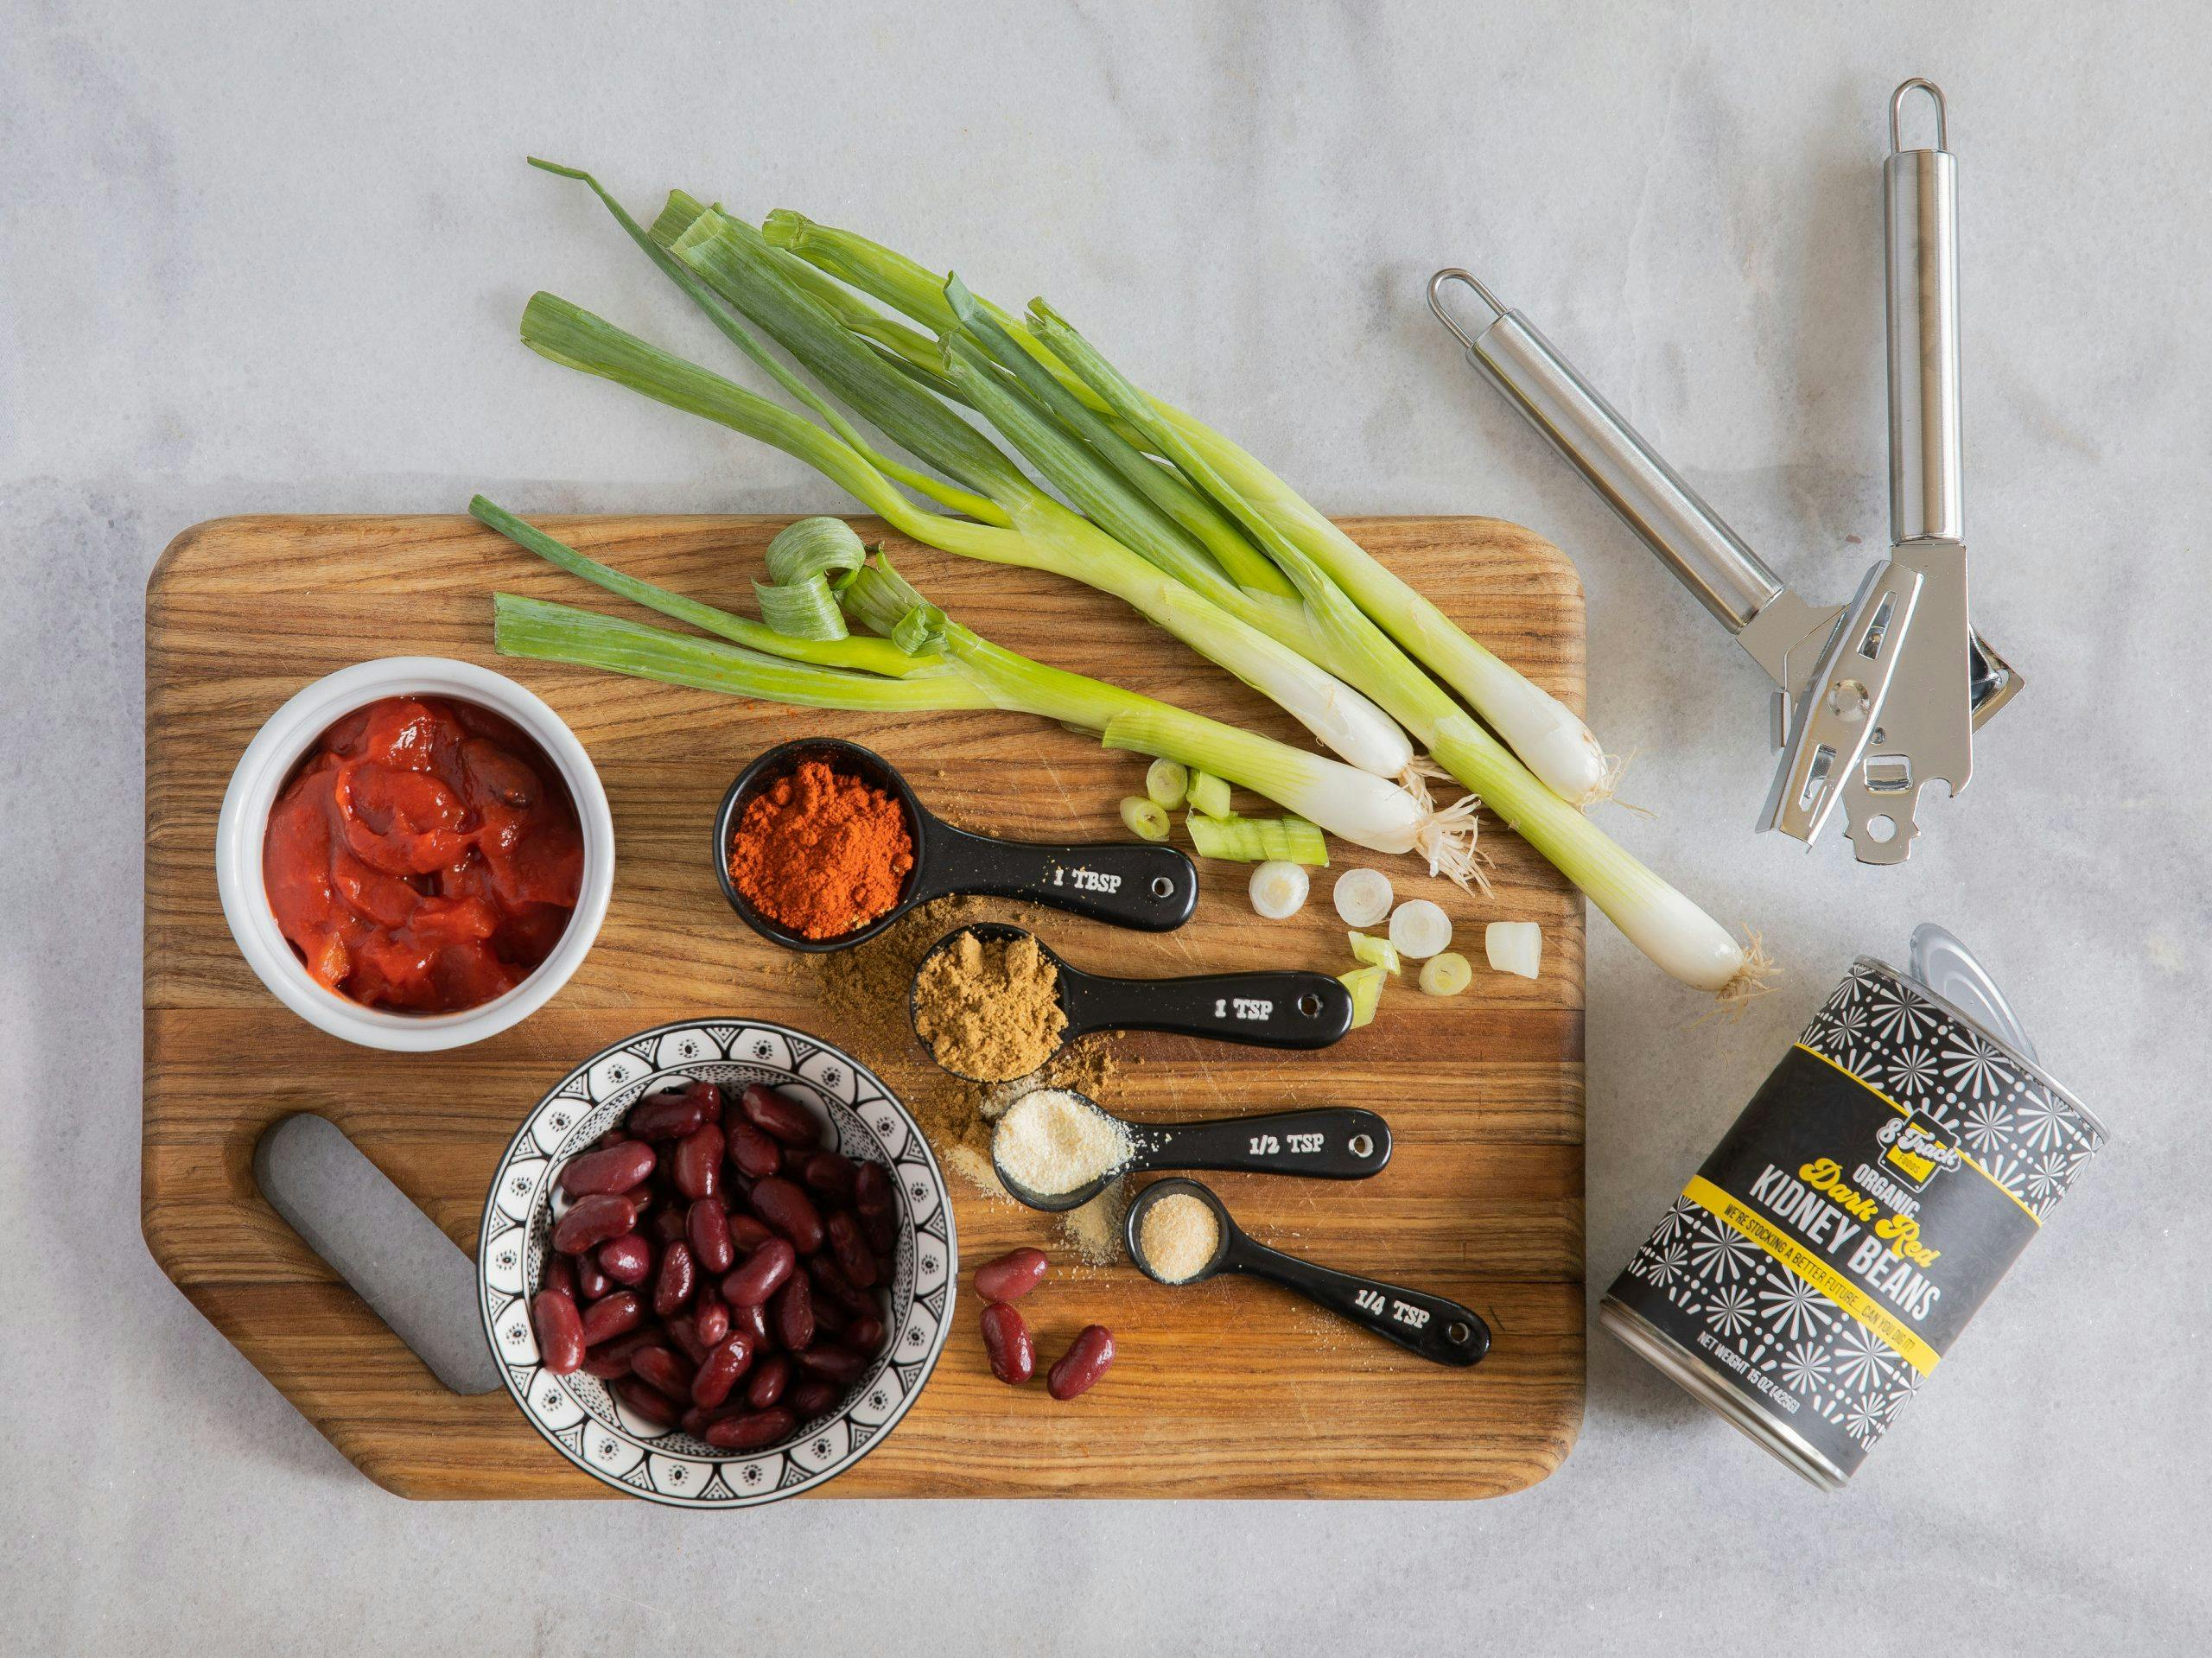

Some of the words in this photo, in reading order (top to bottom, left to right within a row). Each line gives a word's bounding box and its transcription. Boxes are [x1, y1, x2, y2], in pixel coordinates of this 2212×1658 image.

[1053, 867, 1064, 886] 1
[1071, 867, 1122, 893] TBSP
[1215, 999, 1226, 1018] 1
[1233, 998, 1273, 1020] TSP
[1249, 1134, 1280, 1155] 1/2
[1287, 1134, 1324, 1153] TSP
[1799, 1158, 1878, 1222] Dark
[1875, 1214, 1942, 1268] Red
[1853, 1163, 1921, 1219] ORGANIC
[1724, 1203, 1750, 1227] WE'RE
[1745, 1219, 1788, 1254] STOCKING
[1783, 1248, 1794, 1259] A
[1792, 1253, 1827, 1283] BETTER
[1861, 1305, 1882, 1324] CAN
[1878, 1318, 1896, 1336] YOU
[1749, 1164, 1861, 1255] KIDNEY
[1847, 1235, 1941, 1321] BEANS
[1355, 1289, 1386, 1315] 1/4
[1393, 1300, 1430, 1329] TSP
[1697, 1331, 1719, 1350] NET
[1714, 1343, 1751, 1375] WEIGHT
[1746, 1368, 1762, 1384] 15
[1757, 1376, 1774, 1394] OZ
[1769, 1385, 1801, 1414] (425G)
